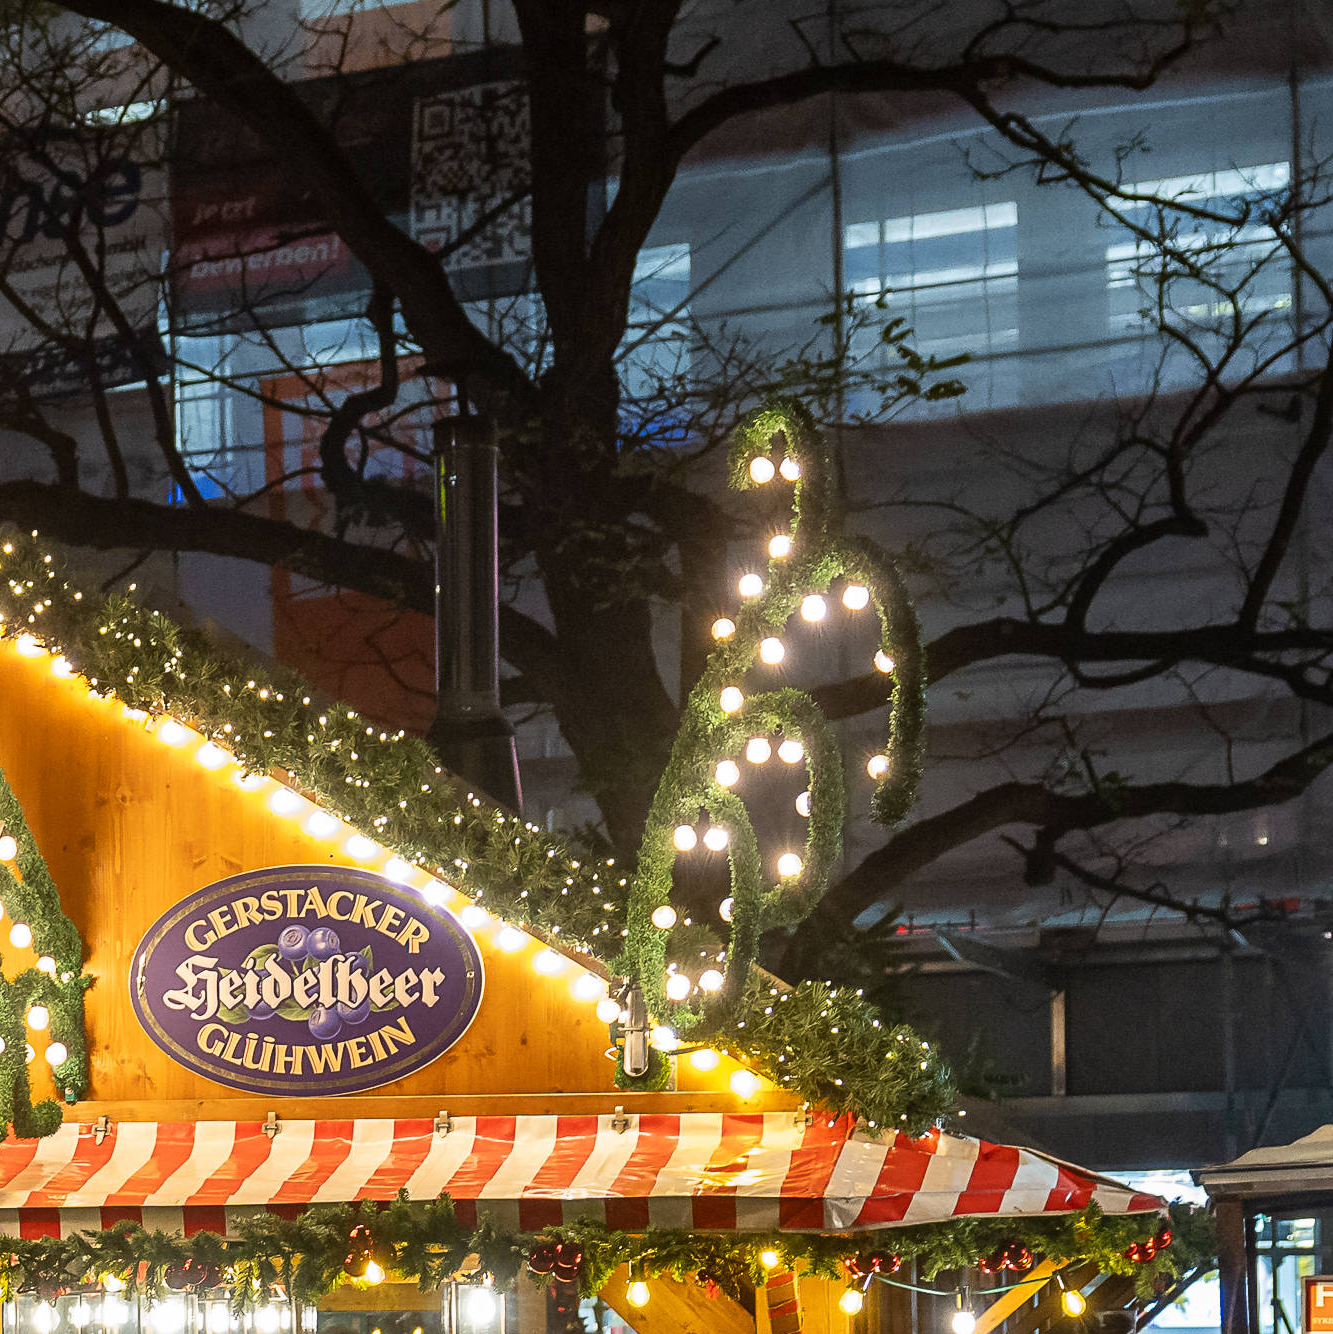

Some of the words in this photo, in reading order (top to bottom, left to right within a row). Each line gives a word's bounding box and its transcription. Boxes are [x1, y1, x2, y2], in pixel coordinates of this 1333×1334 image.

[183, 886, 431, 954] GERSTACKER
[162, 953, 446, 1021] Heidelbeer
[196, 1016, 417, 1076] GLÜHWEIN
